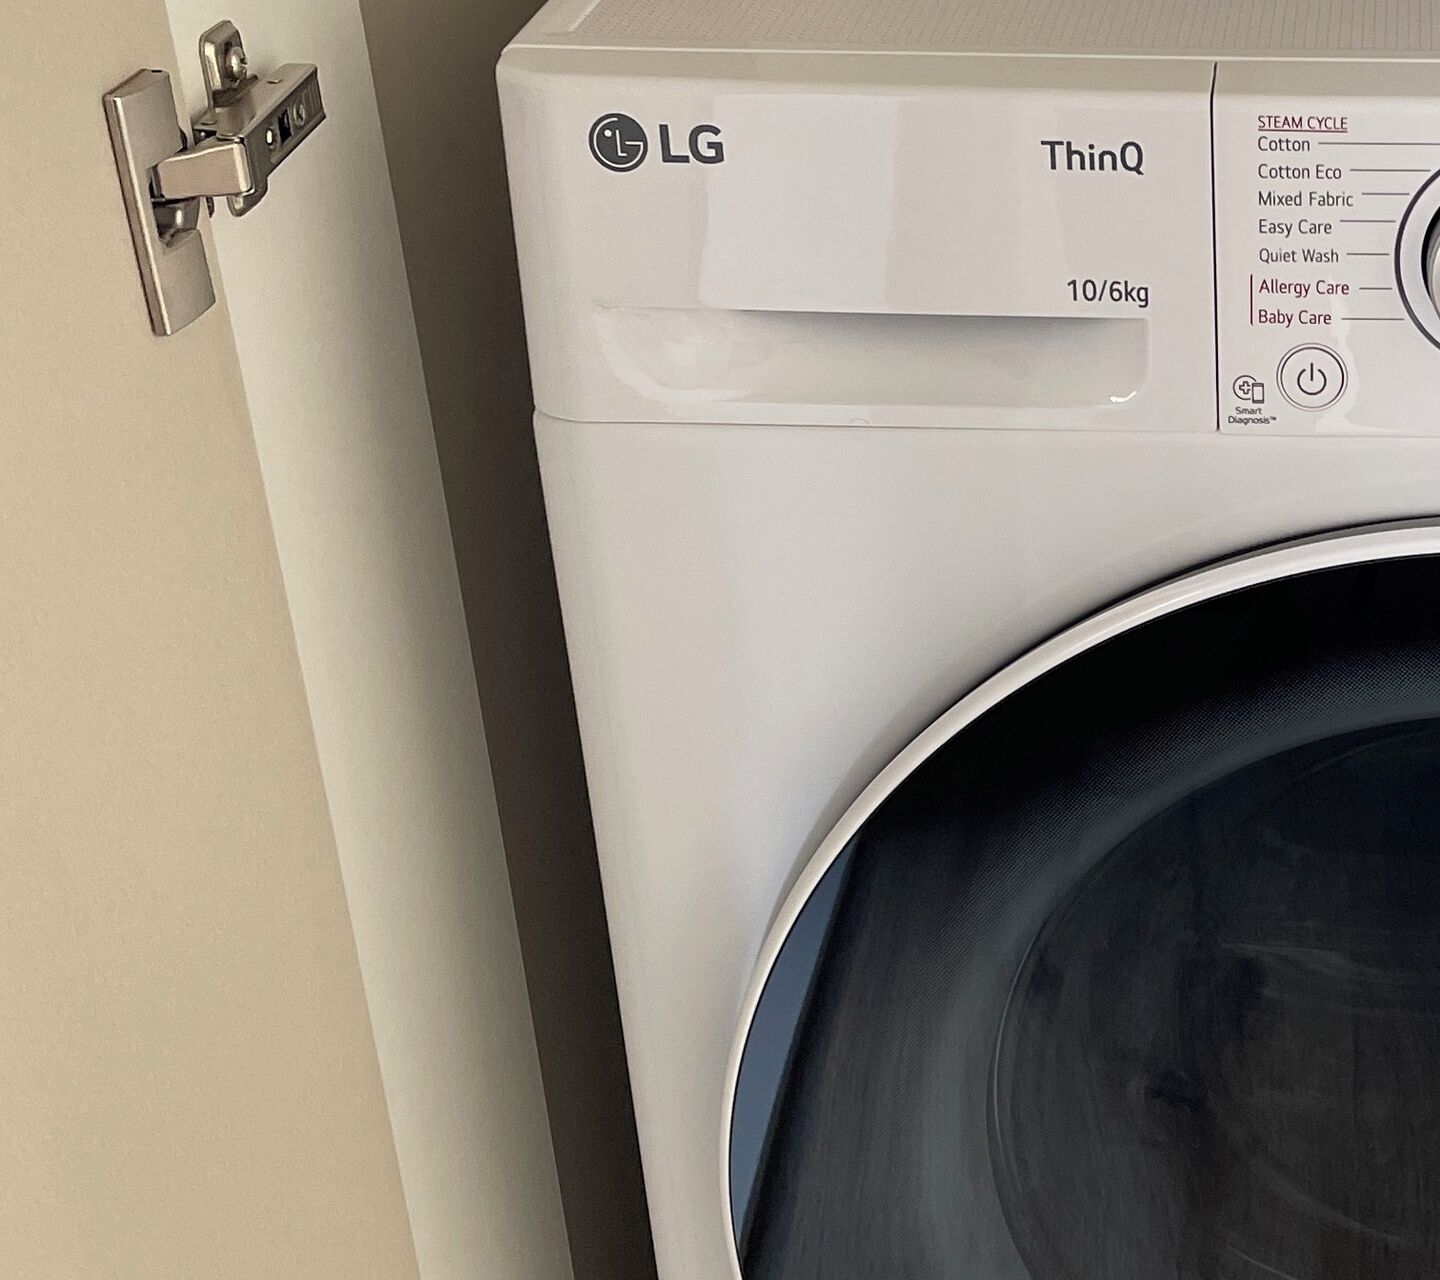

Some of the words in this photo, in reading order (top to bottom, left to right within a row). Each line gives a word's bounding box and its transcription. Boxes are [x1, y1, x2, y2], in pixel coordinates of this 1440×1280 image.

[1258, 116, 1303, 129] STEAM
[1307, 117, 1348, 130] CYCLE
[659, 124, 725, 164] LG
[1258, 136, 1310, 152] Cotton
[1040, 140, 1146, 176] ThinQ
[1258, 164, 1310, 179] Cotton
[1316, 164, 1342, 179] Eco
[1258, 191, 1302, 206] Mixed
[1309, 191, 1354, 207] Fabric
[1258, 219, 1292, 238] Easy
[1298, 219, 1332, 234] Care
[1259, 248, 1297, 264] Quiet
[1302, 249, 1339, 263] Wash
[1067, 279, 1149, 308] 10/6kg
[1259, 279, 1310, 298] Allergy
[1316, 279, 1349, 295] Care
[1258, 309, 1293, 328] Baby
[1299, 310, 1332, 324] Care
[1235, 406, 1263, 415] Smart
